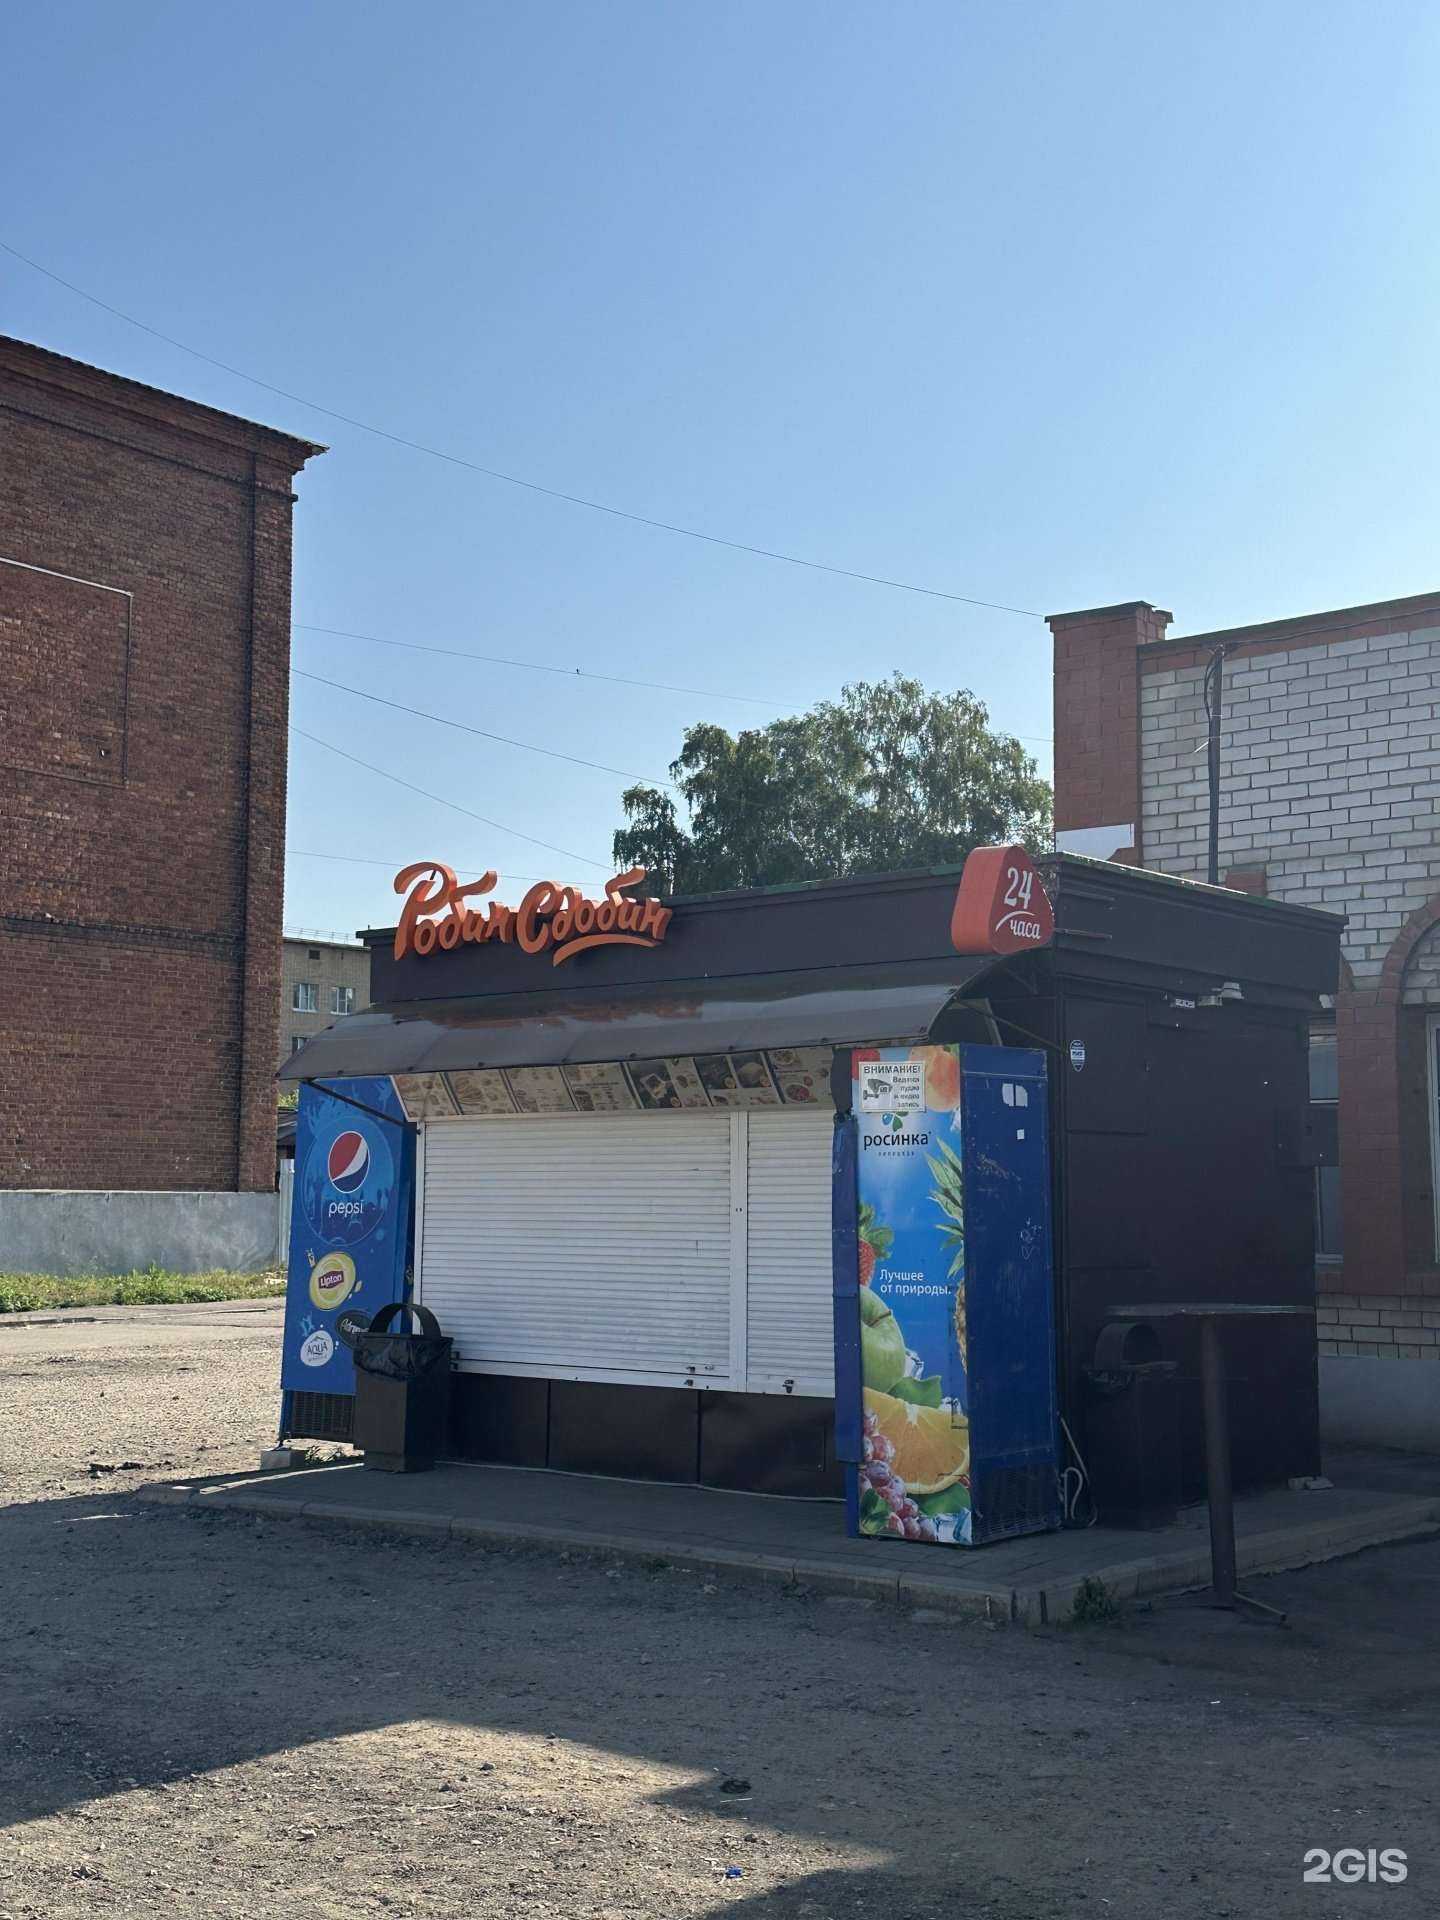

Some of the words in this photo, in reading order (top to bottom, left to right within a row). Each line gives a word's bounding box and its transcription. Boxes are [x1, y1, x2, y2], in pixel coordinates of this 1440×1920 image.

[1004, 867, 1033, 909] 24
[1009, 919, 1041, 940] часа
[863, 1065, 920, 1074] ВНИМАНИЕ!
[864, 1133, 929, 1151] росинка
[328, 1199, 364, 1219] pepsi
[320, 1271, 343, 1286] Lipton
[879, 1268, 924, 1284] Лучшее
[880, 1284, 893, 1293] от
[896, 1284, 952, 1297] природы.
